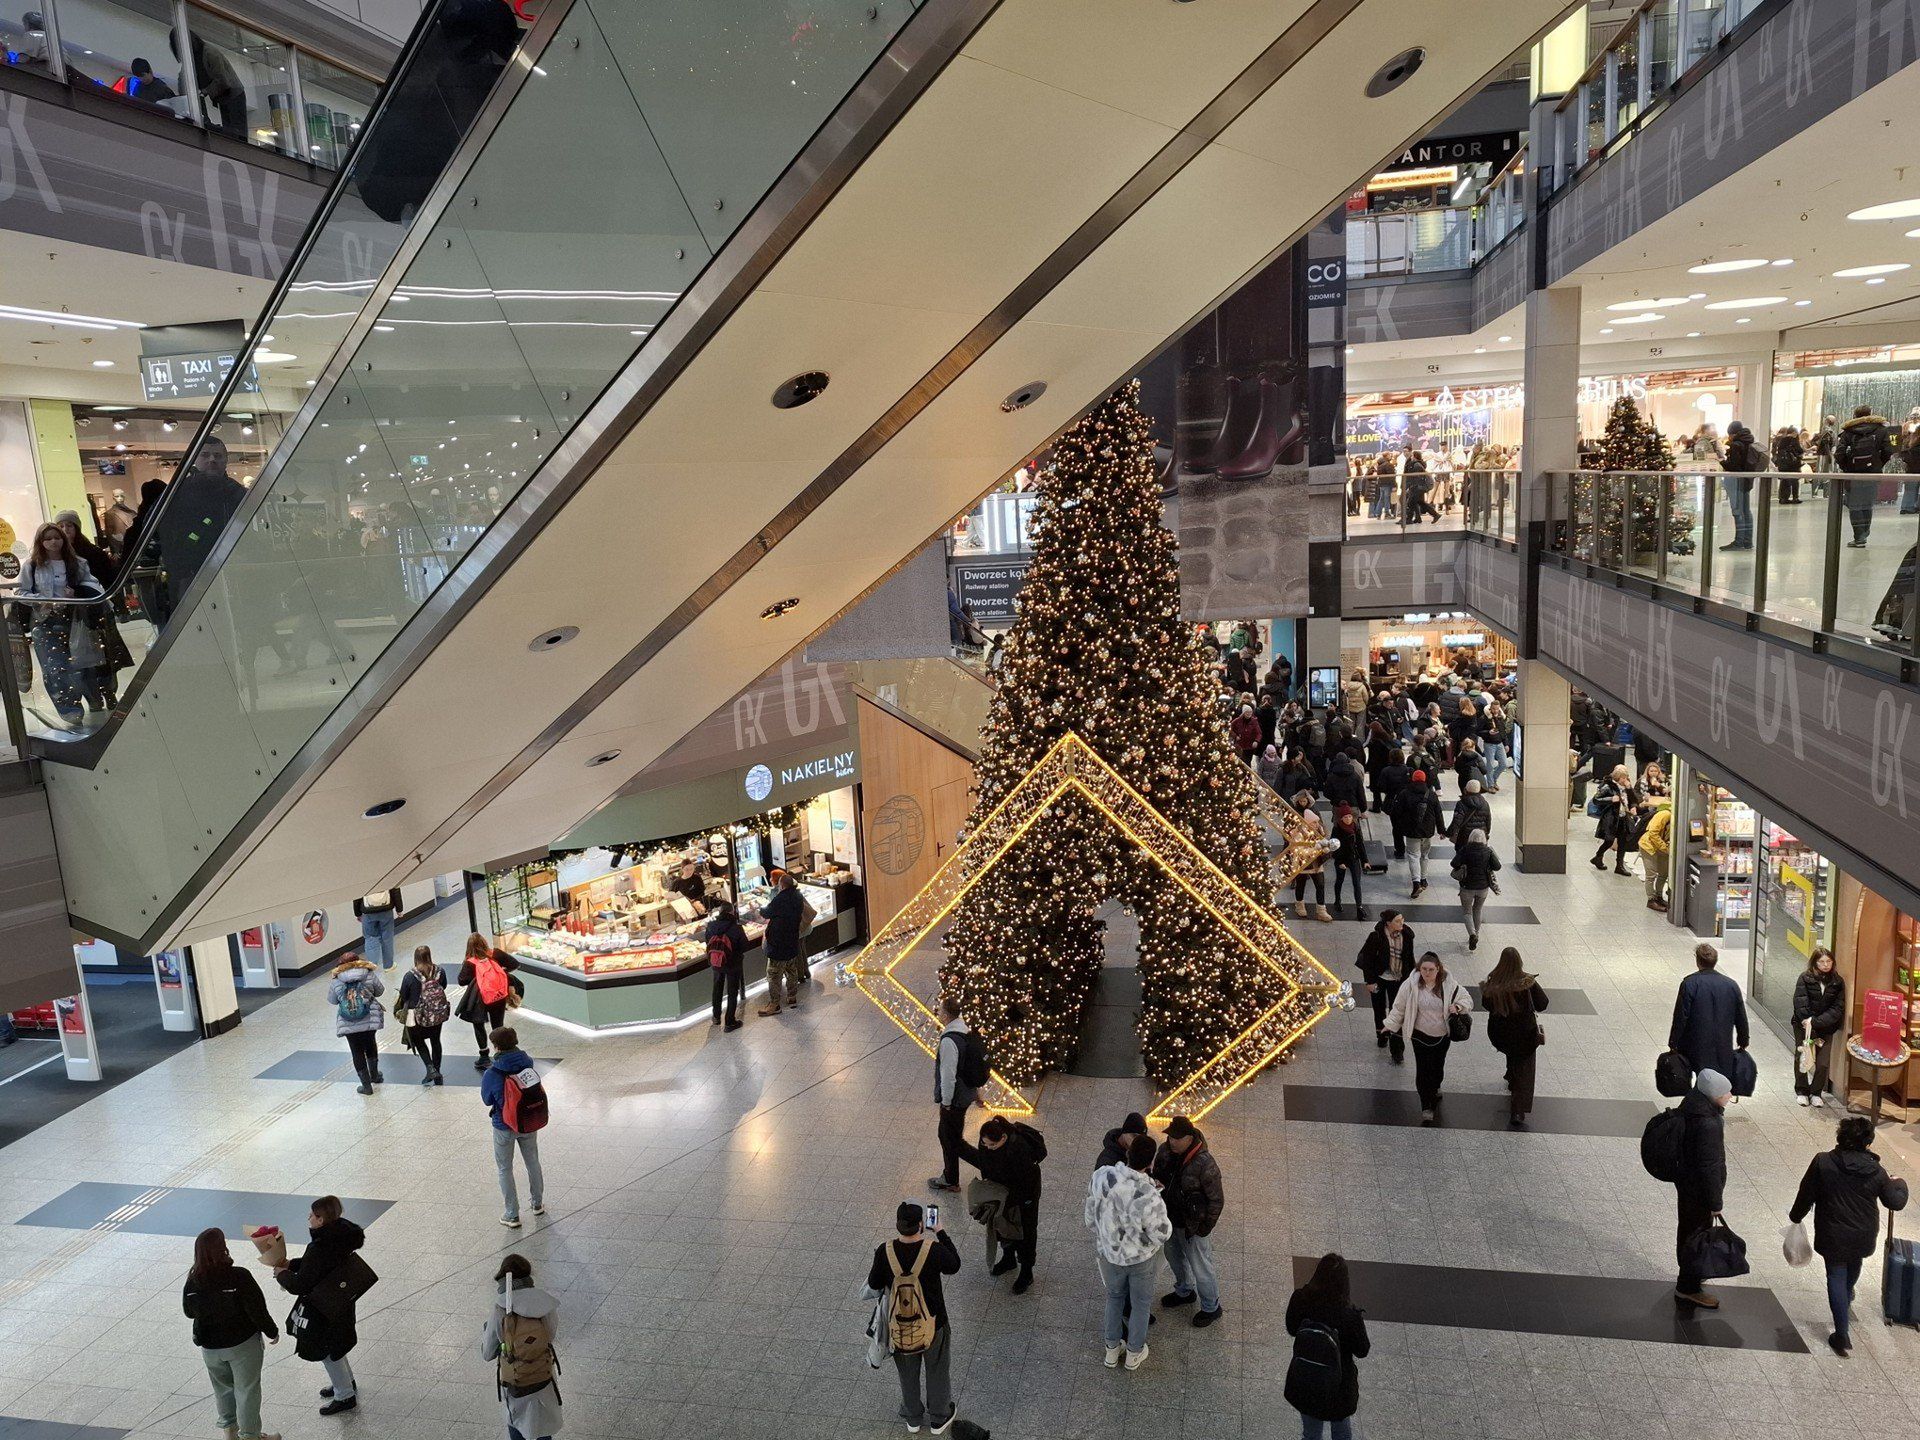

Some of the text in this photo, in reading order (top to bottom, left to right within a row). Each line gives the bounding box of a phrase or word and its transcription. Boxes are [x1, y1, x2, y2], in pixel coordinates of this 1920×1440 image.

[1392, 142, 1482, 164] ANTOR
[181, 359, 213, 375] TAXI
[1358, 433, 1381, 442] LOVE
[964, 569, 1007, 580] Dworzec
[1353, 549, 1382, 589] GK
[966, 597, 1008, 606] Dworzec
[1710, 656, 1732, 750] GK
[1823, 664, 1843, 735] GK
[781, 751, 854, 785] NAKIELNY
[1872, 690, 1912, 819] GK
